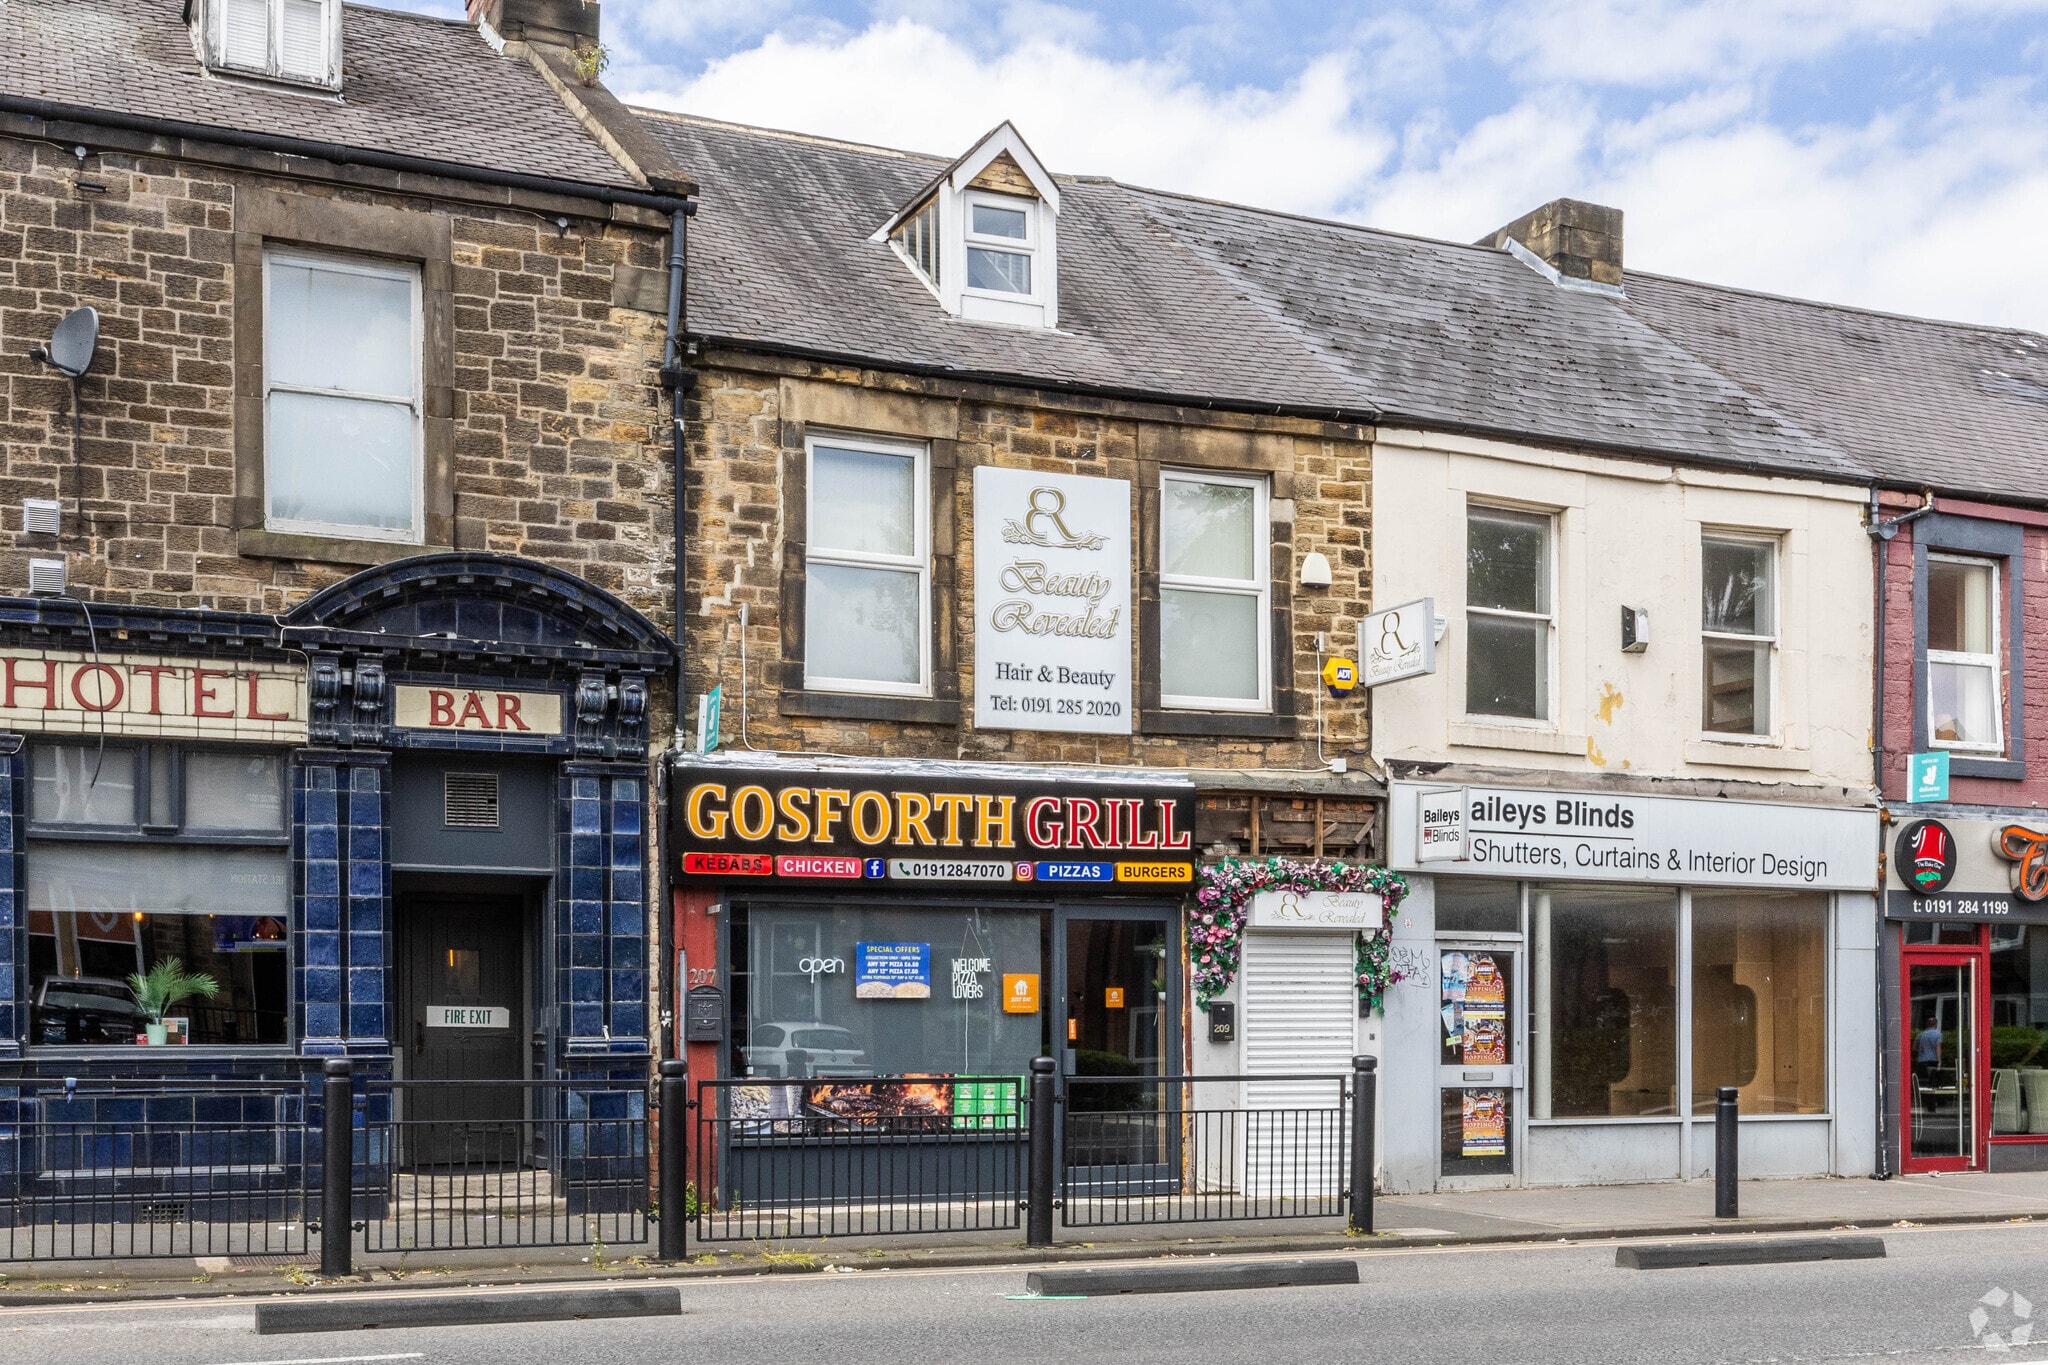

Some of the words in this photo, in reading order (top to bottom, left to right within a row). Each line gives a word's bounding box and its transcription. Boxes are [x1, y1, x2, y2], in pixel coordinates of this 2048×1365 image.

[999, 556, 1111, 607] Beauty
[991, 598, 1121, 640] Revealed
[995, 662, 1032, 682] Hair
[1038, 665, 1053, 683] &
[1057, 666, 1116, 690] Beauty
[1338, 668, 1351, 680] ADT
[2, 658, 289, 721] HOTEL
[429, 690, 531, 730] BAR
[990, 694, 1018, 712] Tel:
[1022, 697, 1052, 714] 0191
[1057, 699, 1083, 714] 285
[1086, 701, 1121, 716] 2020
[686, 782, 1016, 848] GOSFORTH
[1023, 796, 1191, 850] GRILL
[1424, 808, 1460, 824] Baileys
[1471, 796, 1546, 830] aileys
[1556, 800, 1634, 828] Blinds
[1432, 828, 1460, 842] Blinds
[694, 858, 762, 872] KEBABS
[783, 860, 856, 874] CHICKEN
[913, 864, 1004, 878] 01912847070
[1049, 864, 1101, 878] PIZZAS
[1124, 866, 1186, 878] BURGERS
[1474, 838, 1566, 868] Shutters,
[1576, 844, 1660, 870] Curtains
[1668, 848, 1682, 870] &
[1689, 850, 1756, 874] Interior
[1762, 853, 1827, 882] Design
[1322, 894, 1363, 909] Beauty
[1913, 900, 1922, 912] t:
[1925, 900, 1952, 913] 0191
[1958, 900, 1979, 914] 284
[1982, 901, 2008, 914] 1199
[1318, 910, 1366, 924] Revealed
[799, 958, 844, 984] open
[952, 958, 991, 972] WELCOME
[689, 968, 717, 984] 207
[952, 971, 977, 985] PIZZA
[952, 985, 983, 998] LOVERS
[445, 1009, 466, 1024] FIRE
[470, 1010, 492, 1024] EXIT
[1214, 1024, 1230, 1033] 209
